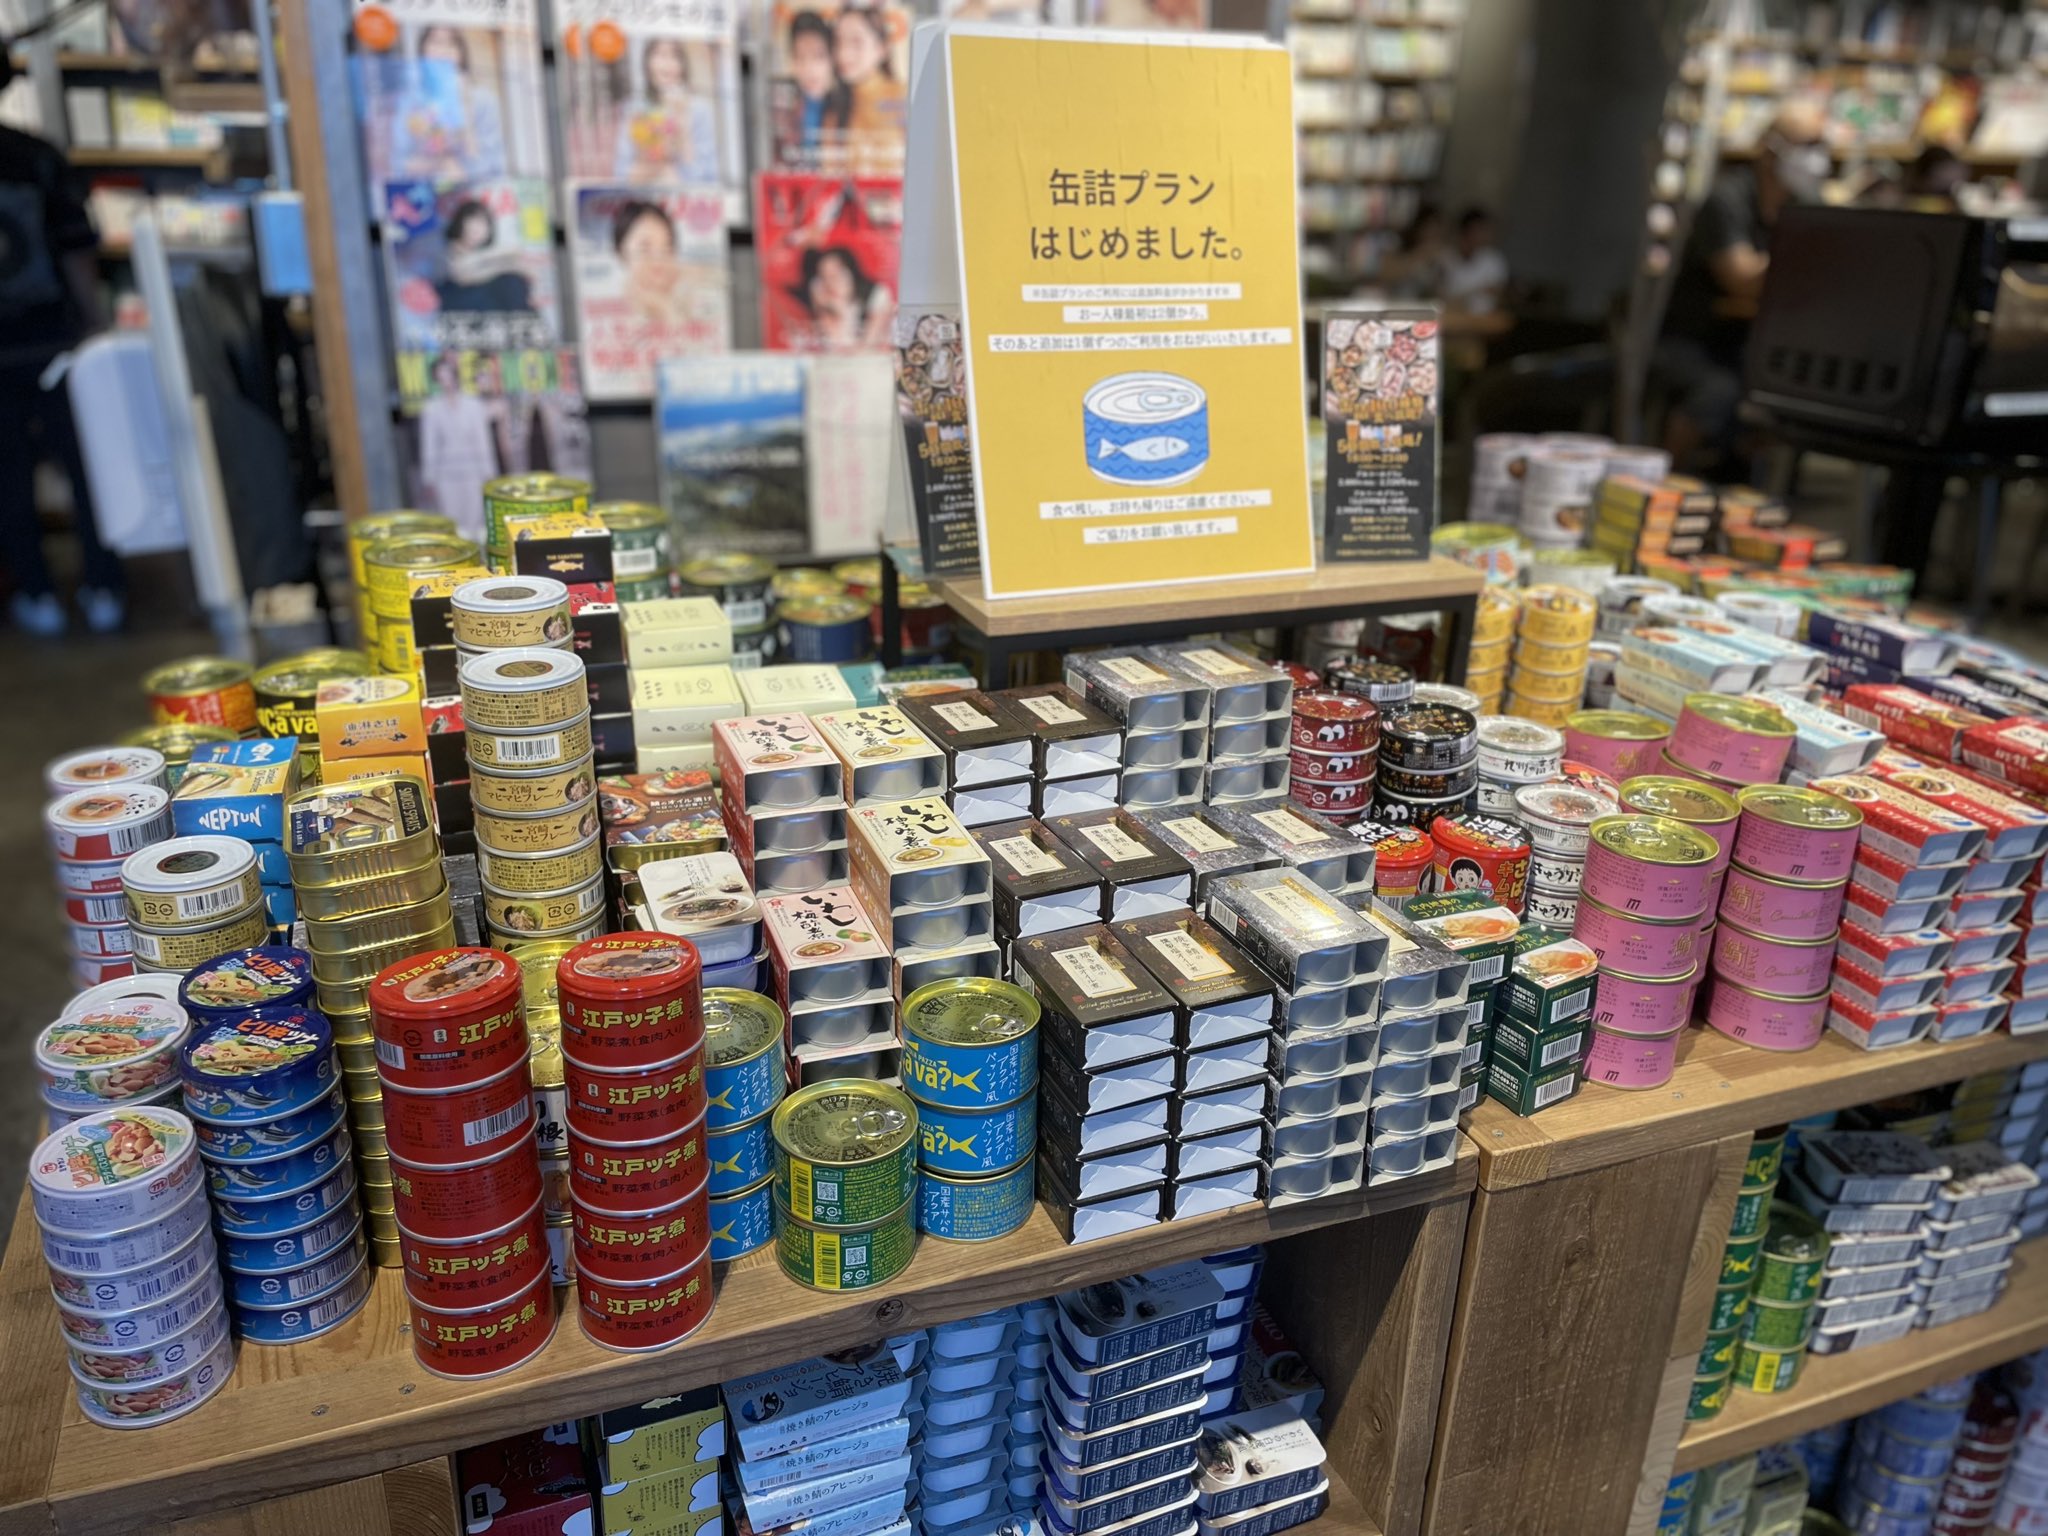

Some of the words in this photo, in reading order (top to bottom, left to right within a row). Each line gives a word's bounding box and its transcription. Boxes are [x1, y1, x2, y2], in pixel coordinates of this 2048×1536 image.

[1049, 168, 1215, 207] 缶詰プラン
[1031, 225, 1243, 261] はじめました。
[467, 627, 541, 638] マヒマヒフレーク
[490, 621, 511, 630] 宮崎
[398, 786, 416, 810] SMOKED
[487, 789, 563, 804] マヒマヒフレーク
[509, 784, 532, 795] 宮崎
[198, 805, 262, 831] NEPTUN
[402, 807, 421, 832] SPRATS
[526, 824, 549, 835] 宮崎
[900, 804, 950, 834] いわし
[500, 826, 577, 844] マヒマヒフレーク
[801, 892, 857, 927] いわし
[605, 939, 682, 950] 江戸ッ子煮
[245, 953, 303, 985] ピリ辛ツナ
[80, 1012, 176, 1027] ピリ辛ツナ
[582, 998, 684, 1030] 江戸ッ子煮
[236, 1018, 320, 1044] ピリ辛ツナ
[591, 1022, 686, 1048] 野菜煮(食肉入り)
[608, 1062, 701, 1106] 江戸ッ子煮
[915, 1062, 951, 1091] va?
[602, 1138, 697, 1177] 江戸ッ子煮
[589, 1216, 686, 1246] 江戸ッ子煮
[427, 1233, 530, 1275] 江戸ッ子煮
[607, 1276, 700, 1316] 江戸ッ子煮
[437, 1301, 537, 1342] 江戸ッ子煮
[786, 1400, 869, 1433] 焼き鯖のアヒージョ
[786, 1440, 869, 1468] 焼き鯖のアヒージョ
[793, 1474, 874, 1508] 焼き鯖のアヒージョ
